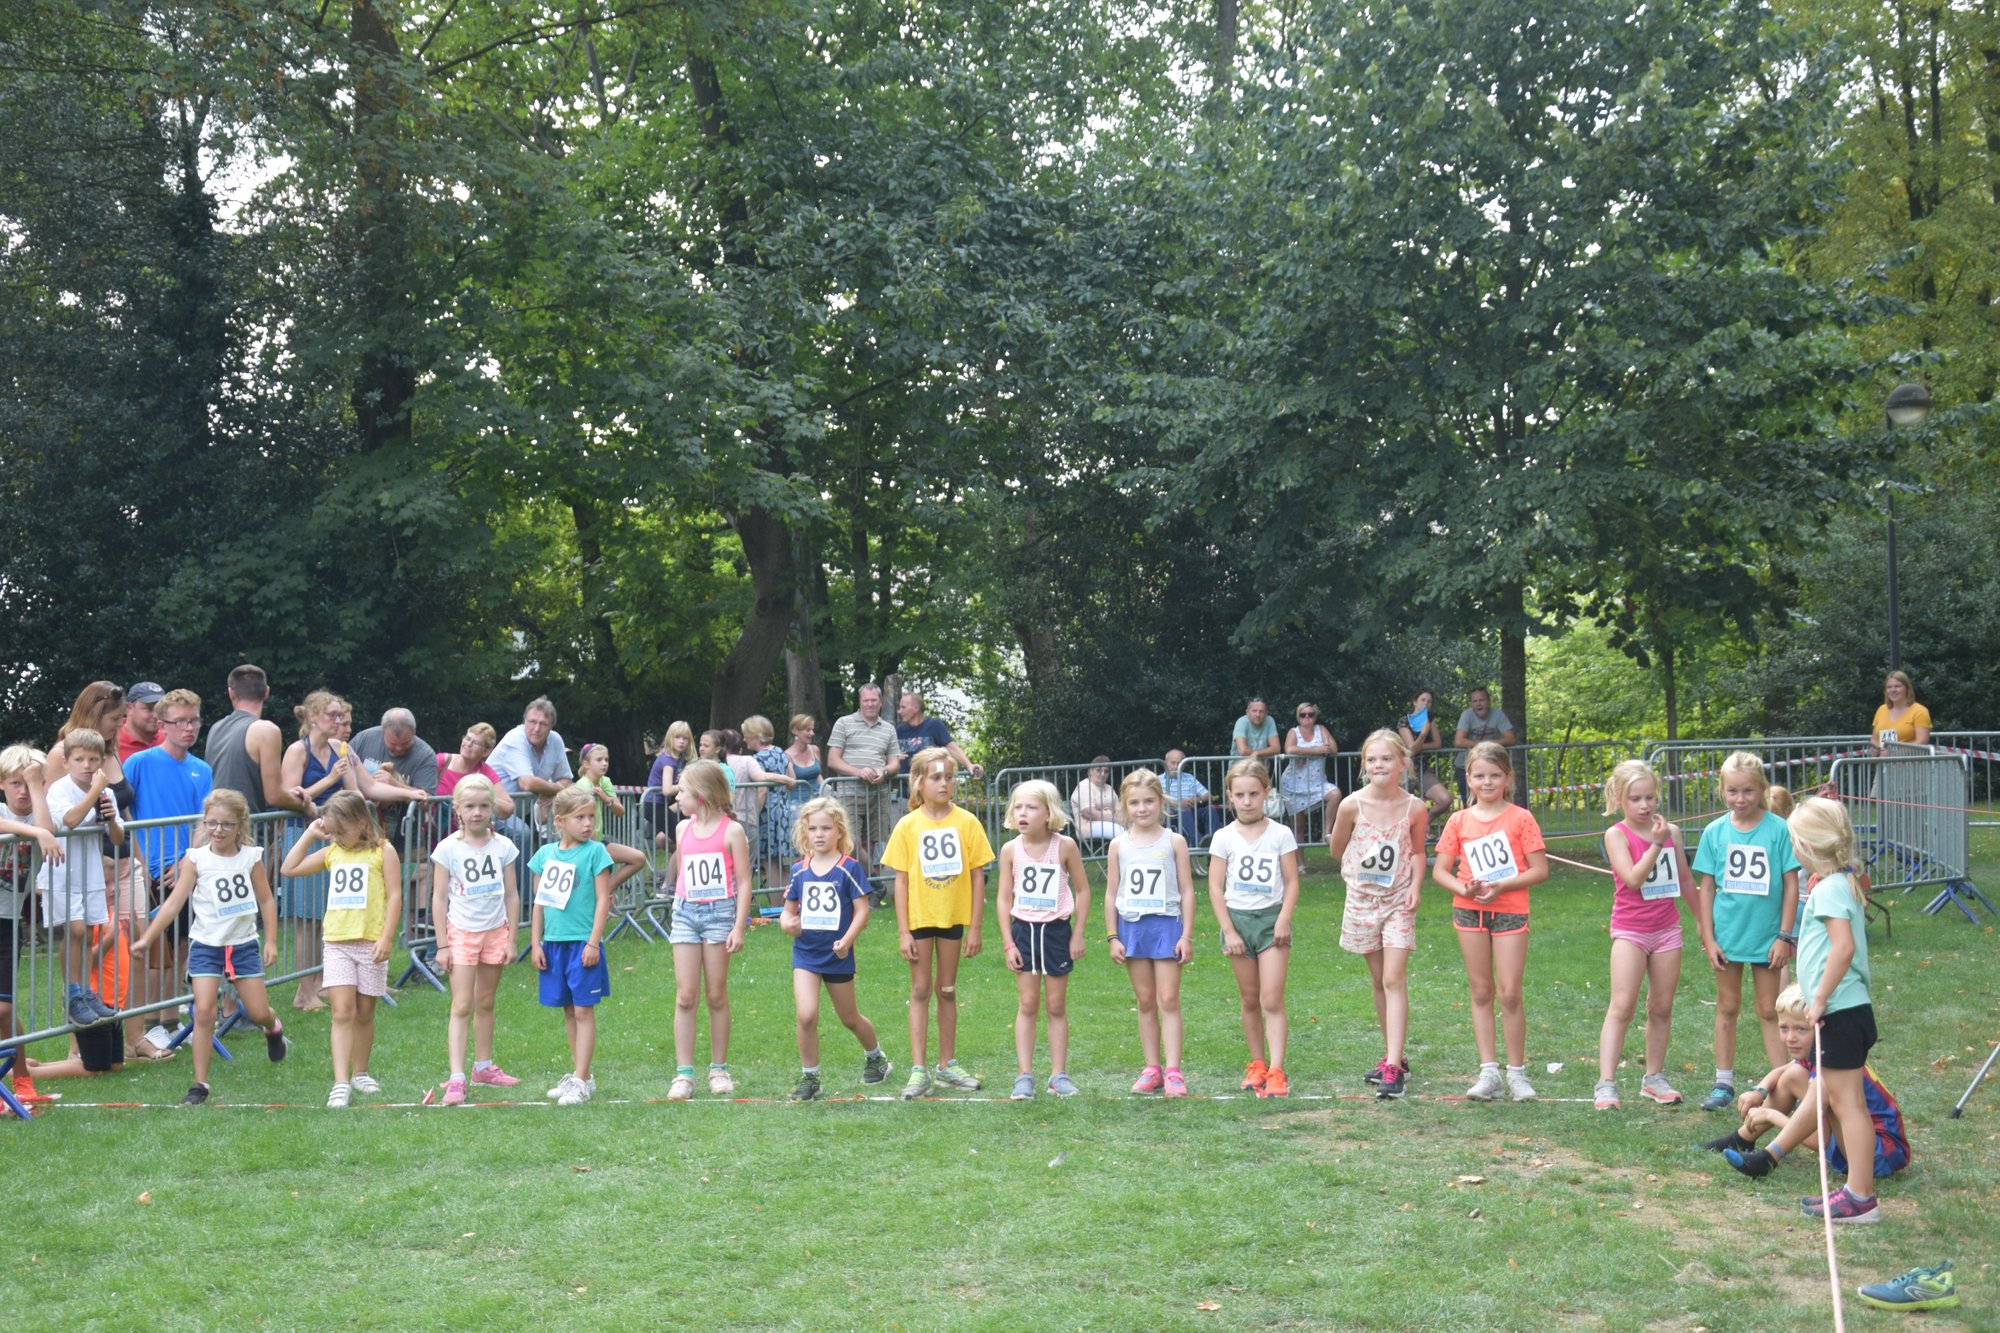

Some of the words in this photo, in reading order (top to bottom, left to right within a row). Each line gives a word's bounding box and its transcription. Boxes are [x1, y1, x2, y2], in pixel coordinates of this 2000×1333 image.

[923, 832, 956, 861] 86
[1470, 838, 1509, 871] 103
[463, 854, 497, 883] 84
[687, 858, 722, 886] 104
[1238, 855, 1273, 883] 85
[1729, 850, 1767, 880] 95
[215, 873, 249, 903] 88
[334, 867, 362, 893] 98
[543, 866, 573, 893] 96
[1022, 866, 1056, 893] 87
[1130, 868, 1162, 895] 97
[807, 885, 837, 912] 83
